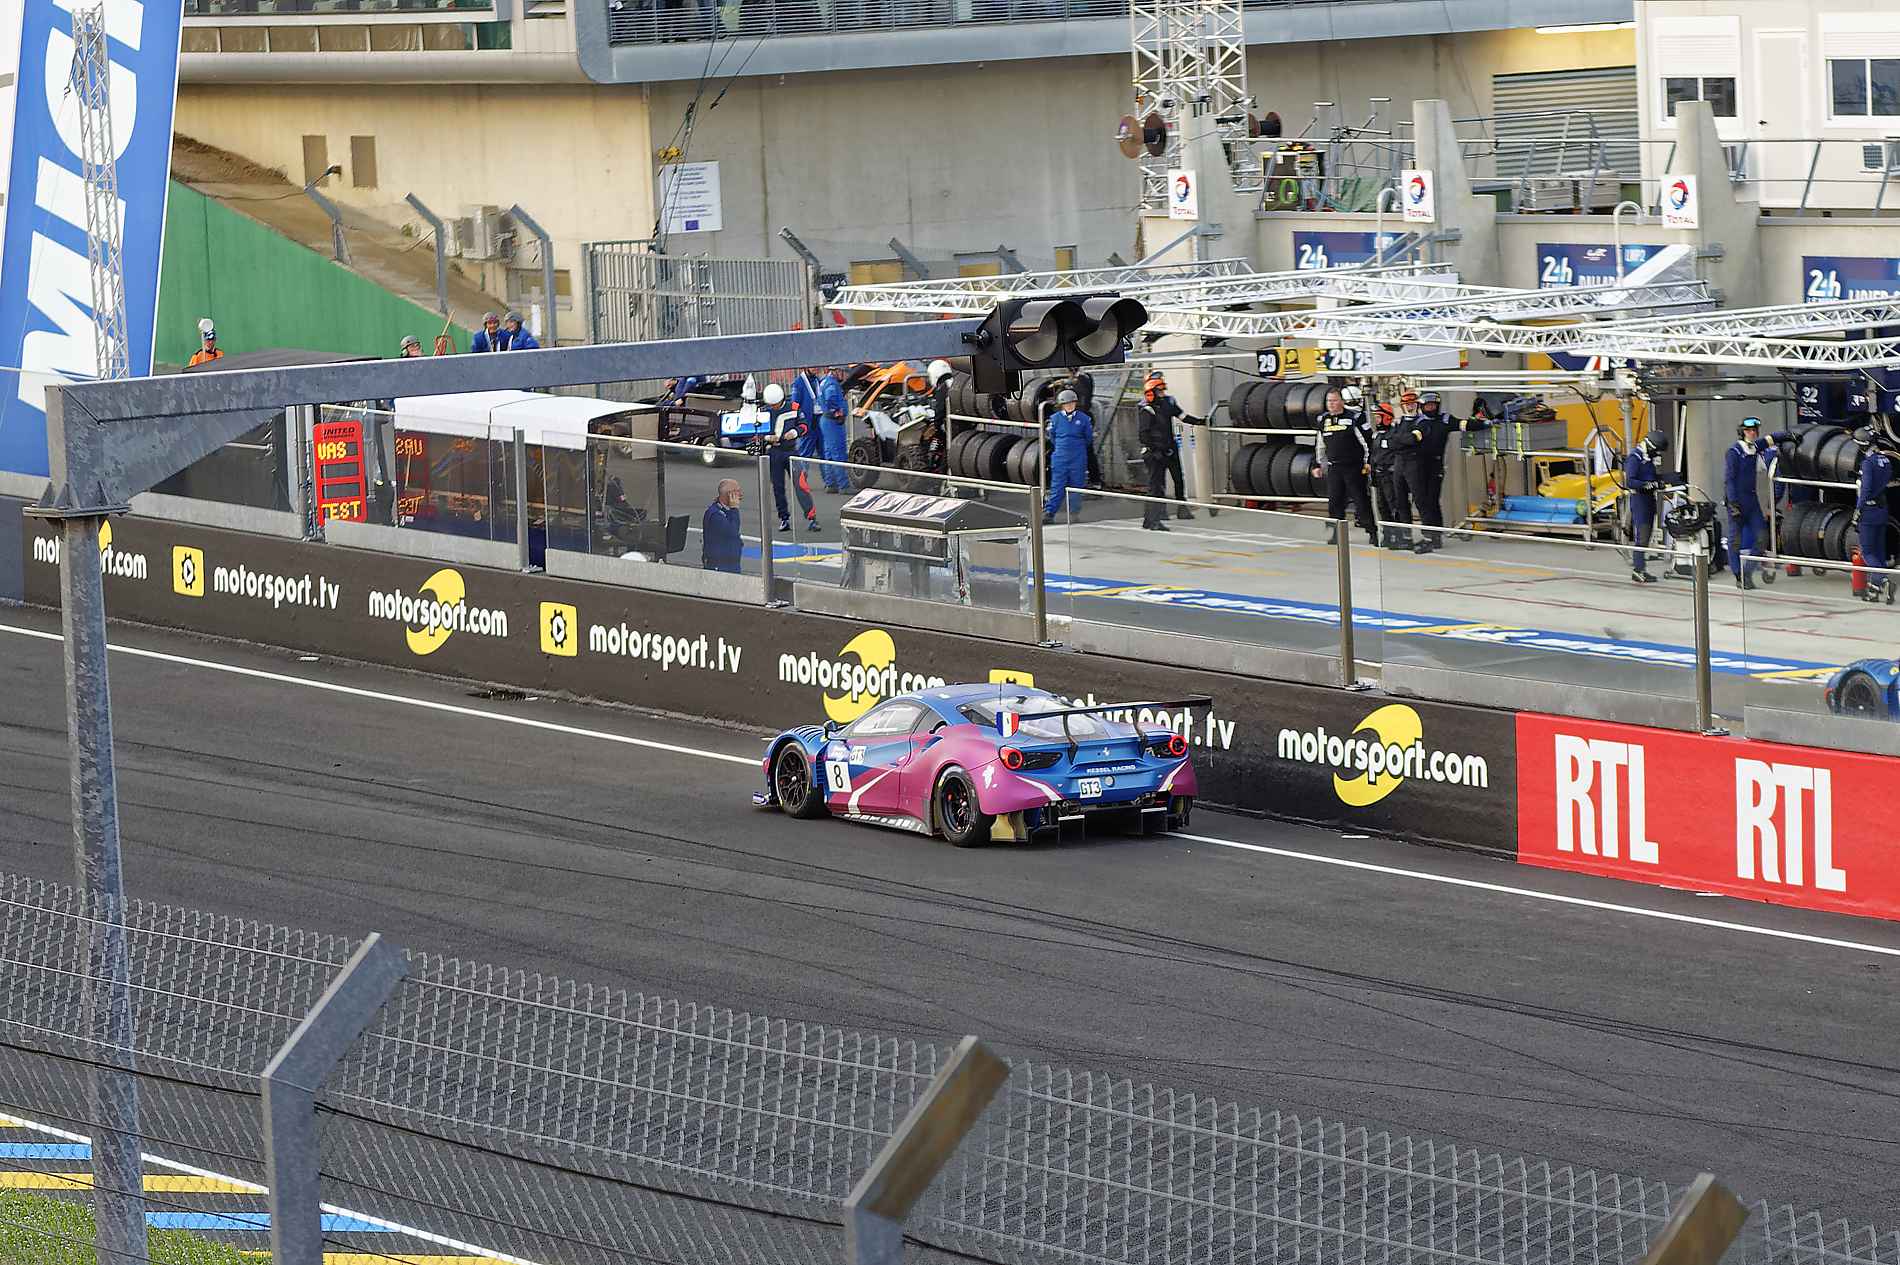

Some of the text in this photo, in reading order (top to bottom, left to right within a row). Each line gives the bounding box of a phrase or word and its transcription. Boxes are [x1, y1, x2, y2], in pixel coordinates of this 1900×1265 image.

[1258, 353, 1277, 373] 29
[1328, 349, 1354, 370] 29
[33, 535, 147, 579] motrt.com
[213, 564, 340, 610] motorsport.tv
[368, 588, 508, 638] motorsport.com
[588, 622, 742, 674] motorsport.tv
[833, 764, 844, 789] 8
[1277, 726, 1488, 789] motorsport.com
[1080, 780, 1102, 796] GT3
[1554, 732, 1660, 866] RTL
[1734, 756, 1847, 893] RTL
